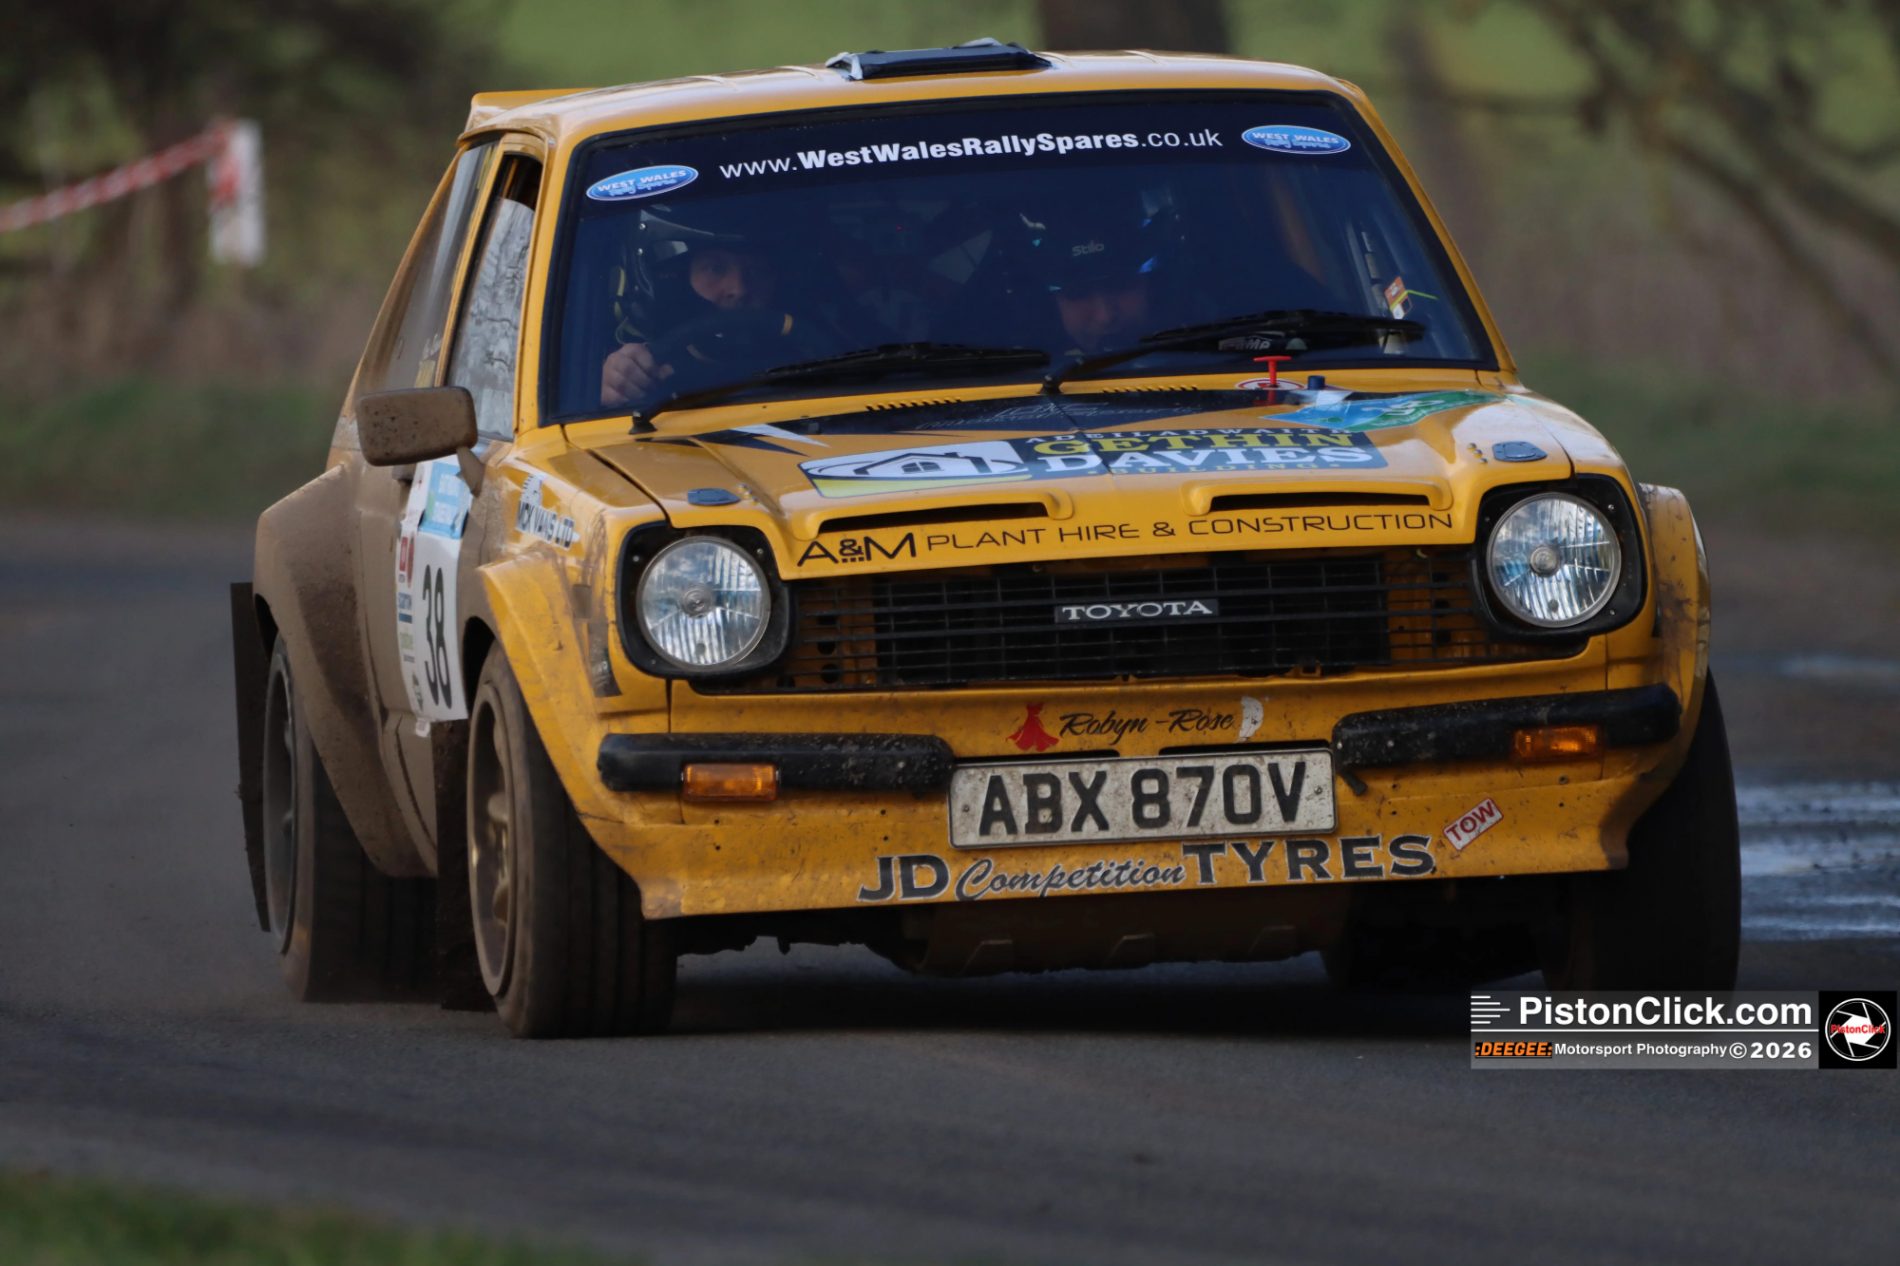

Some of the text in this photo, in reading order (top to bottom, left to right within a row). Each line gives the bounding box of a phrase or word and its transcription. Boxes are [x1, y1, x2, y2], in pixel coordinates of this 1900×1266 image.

[719, 129, 1222, 179] www.WestWalesRallySpares.co.uk
[1252, 132, 1339, 143] WEST WALES
[597, 170, 686, 191] WEST WALES
[1033, 434, 1353, 455] GETHIN
[1037, 447, 1373, 472] DAVIES
[926, 528, 1046, 551] PLANT
[1058, 523, 1140, 543] HIRE
[1152, 521, 1176, 537] &
[1188, 513, 1453, 536] CONSTRUCTION
[1062, 601, 1213, 620] TOYOTA
[422, 564, 452, 709] 38
[1059, 709, 1148, 746] Robyn
[979, 761, 1306, 836] ABX 870V
[1446, 801, 1495, 841] TOW
[858, 834, 1437, 901] JD Competition TYRES
